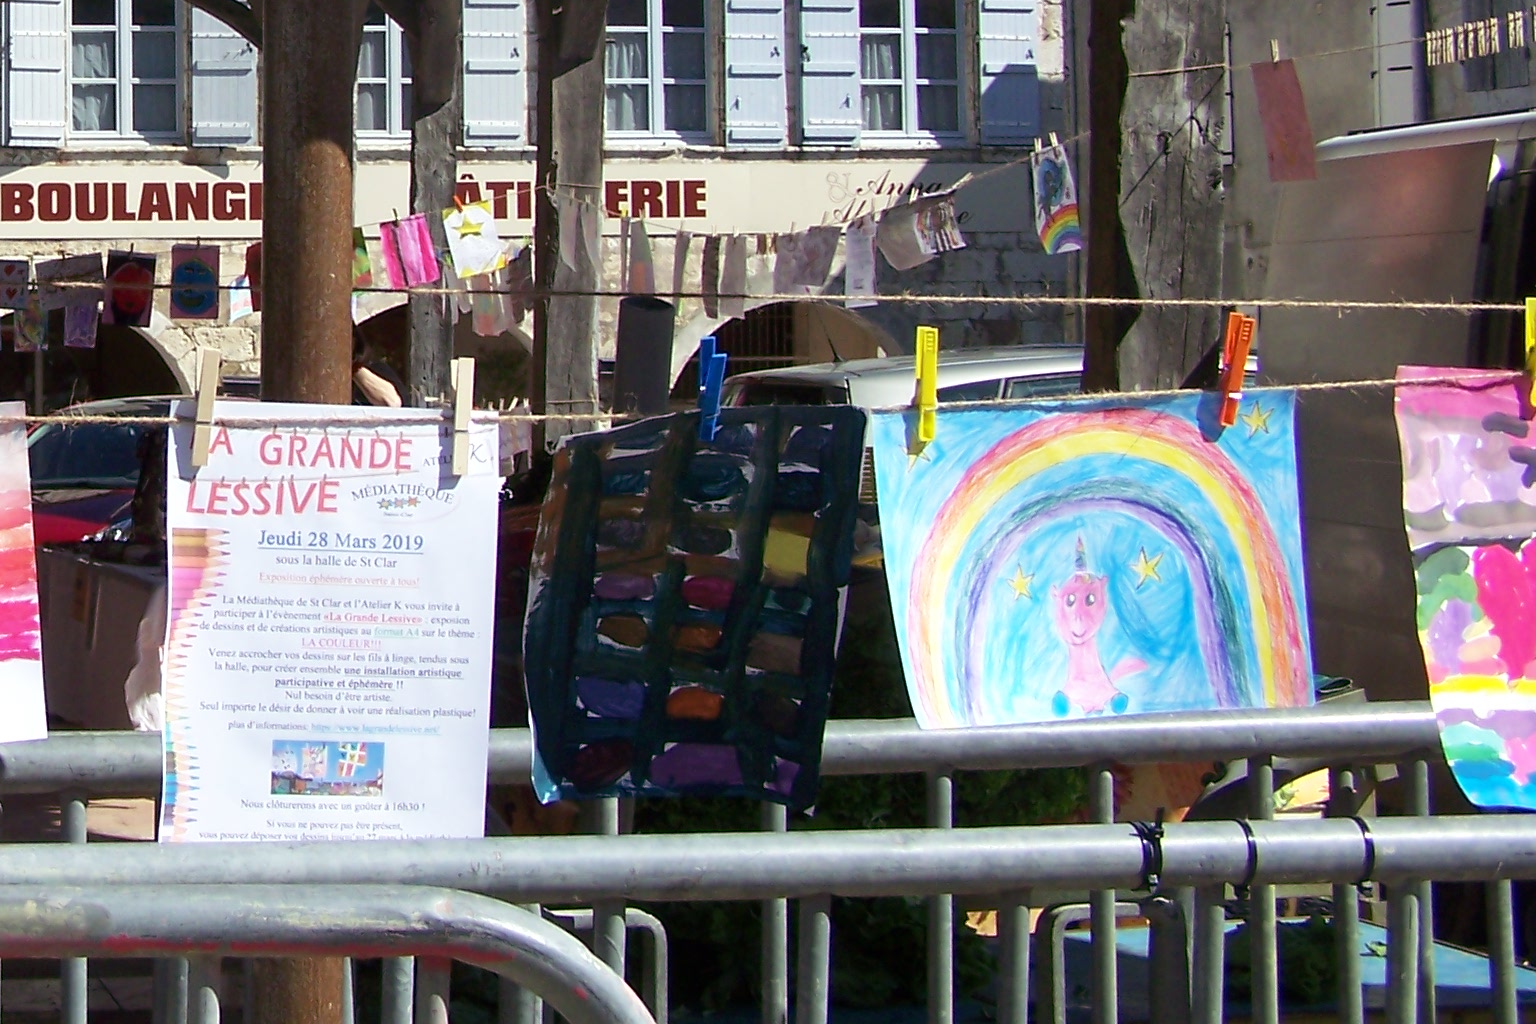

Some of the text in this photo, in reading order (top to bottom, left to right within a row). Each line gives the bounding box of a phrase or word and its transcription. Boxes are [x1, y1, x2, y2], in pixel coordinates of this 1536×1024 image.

[1, 183, 262, 221] BOULANG
[191, 425, 413, 470] A GRANDE
[186, 480, 340, 516] LESSIVE
[351, 482, 454, 505] MÉDIATHÈQUE
[258, 530, 424, 551] Jeudi 28 Mars 2019
[275, 554, 398, 568] sous la halle de St Clar
[259, 572, 307, 584] Exposition
[354, 576, 387, 586] ouverte
[222, 595, 234, 604] La
[237, 595, 293, 607] Médiathèque
[296, 597, 308, 607] de
[310, 598, 319, 607] St
[321, 598, 342, 608] Clar
[344, 599, 352, 608] et
[394, 600, 402, 610] K
[404, 602, 425, 611] vous
[427, 602, 453, 612] invite
[455, 603, 461, 612] à
[213, 609, 256, 620] participer
[258, 608, 264, 618] à
[344, 612, 379, 623] Grande
[199, 621, 210, 631] de
[212, 622, 245, 632] dessins
[247, 623, 255, 632] et
[257, 623, 268, 633] de
[270, 624, 311, 634] créations
[313, 626, 359, 637] artistiques
[360, 627, 372, 636] au
[374, 626, 404, 637] format
[406, 627, 420, 637] A4
[421, 629, 435, 637] sur
[437, 628, 445, 638] le
[302, 637, 316, 647] LA
[209, 648, 236, 658] Venez
[238, 650, 282, 660] accrocher
[284, 652, 300, 660] vos
[302, 651, 335, 662] dessins
[337, 653, 351, 661] sur
[353, 653, 366, 662] les
[368, 653, 382, 663] fils
[384, 654, 390, 663] à
[419, 655, 448, 664] tendus
[450, 656, 470, 665] sous
[214, 660, 223, 671] la
[252, 663, 272, 674] pour
[274, 663, 298, 673] créer
[299, 664, 342, 675] ensemble
[344, 666, 362, 675] une
[364, 665, 416, 677] installation
[418, 668, 463, 679] artistique
[275, 677, 335, 689] participative
[336, 679, 346, 688] et
[348, 679, 394, 691] éphémère
[285, 690, 302, 699] Nul
[304, 690, 333, 701] besoin
[199, 701, 219, 711] Seul
[221, 702, 256, 713] importe
[258, 702, 267, 712] le
[268, 703, 291, 713] désir
[293, 703, 304, 714] de
[305, 704, 337, 715] donner
[339, 705, 345, 715] à
[347, 706, 365, 715] voir
[367, 706, 383, 716] une
[385, 706, 431, 717] réalisation
[228, 720, 245, 731] plus
[240, 798, 264, 809] Nous
[317, 802, 339, 811] avec
[341, 803, 352, 811] un
[392, 802, 420, 812] 16h30
[266, 819, 275, 828] Si
[277, 820, 296, 829] vous
[309, 821, 339, 831] pouvez
